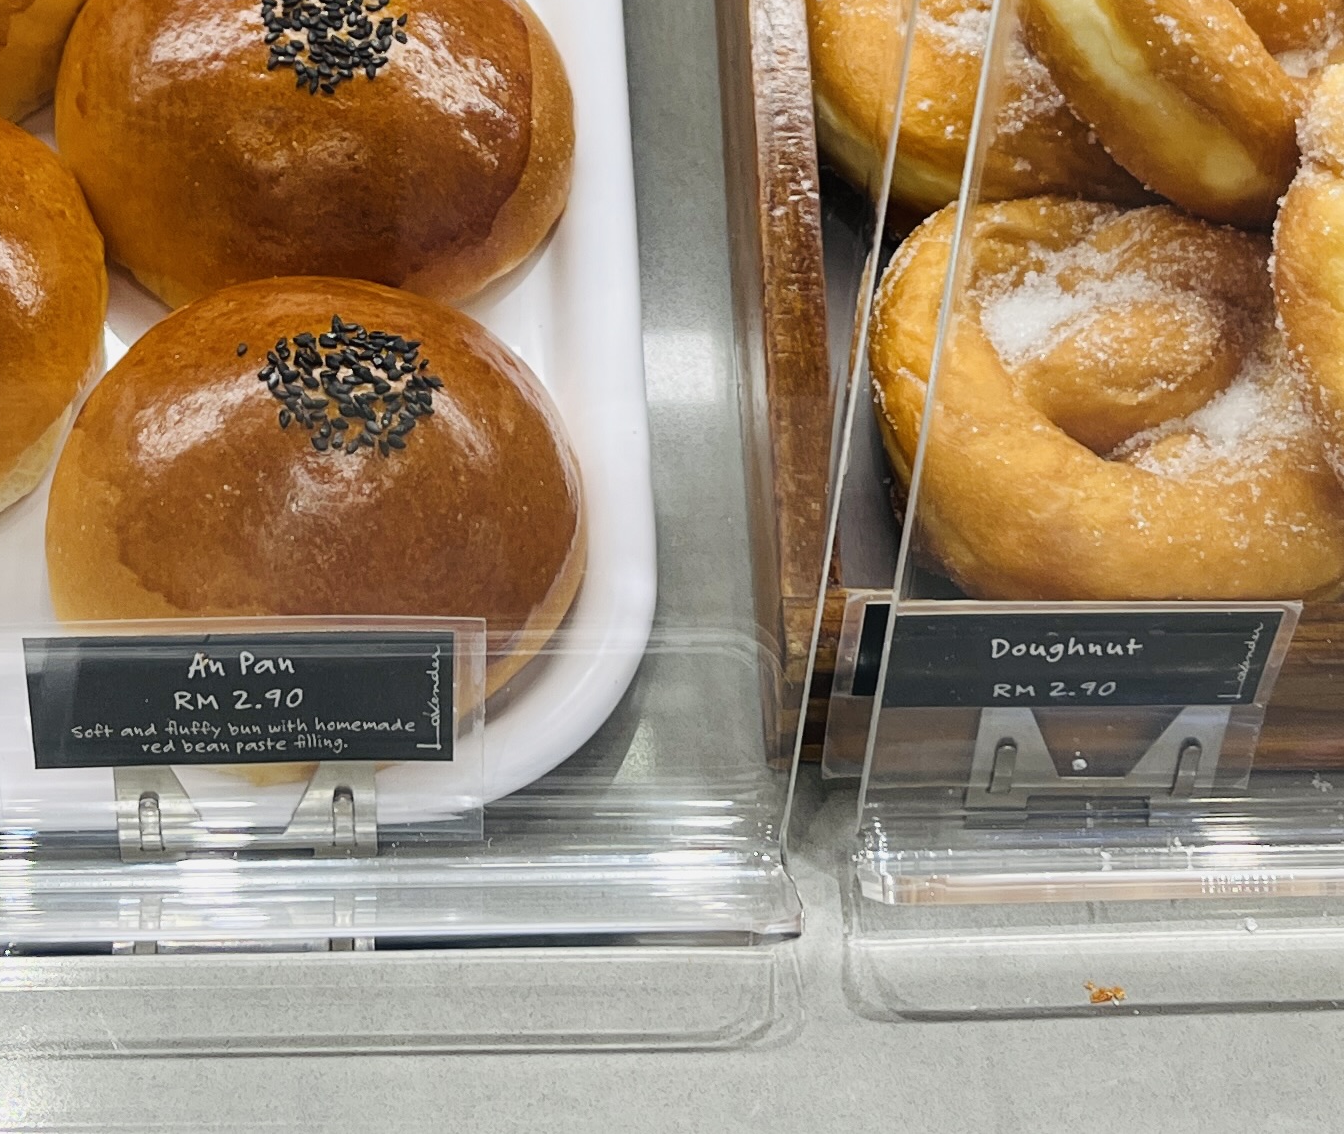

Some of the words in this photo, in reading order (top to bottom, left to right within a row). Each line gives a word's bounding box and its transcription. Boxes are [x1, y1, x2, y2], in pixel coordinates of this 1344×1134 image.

[990, 636, 1144, 663] Doughnut
[187, 651, 226, 679] An
[239, 650, 296, 676] Pan
[173, 690, 220, 711] RM
[232, 687, 304, 710] 2.90
[992, 683, 1036, 698] RM
[1049, 681, 1117, 697] 2.90
[120, 722, 158, 738] and
[164, 720, 222, 739] fluffy
[227, 721, 262, 736] bun
[268, 717, 309, 734] with
[314, 716, 416, 733] homemade
[141, 739, 176, 754] red
[181, 738, 230, 754] bean
[236, 737, 287, 755] paste
[293, 733, 349, 754] filling.
